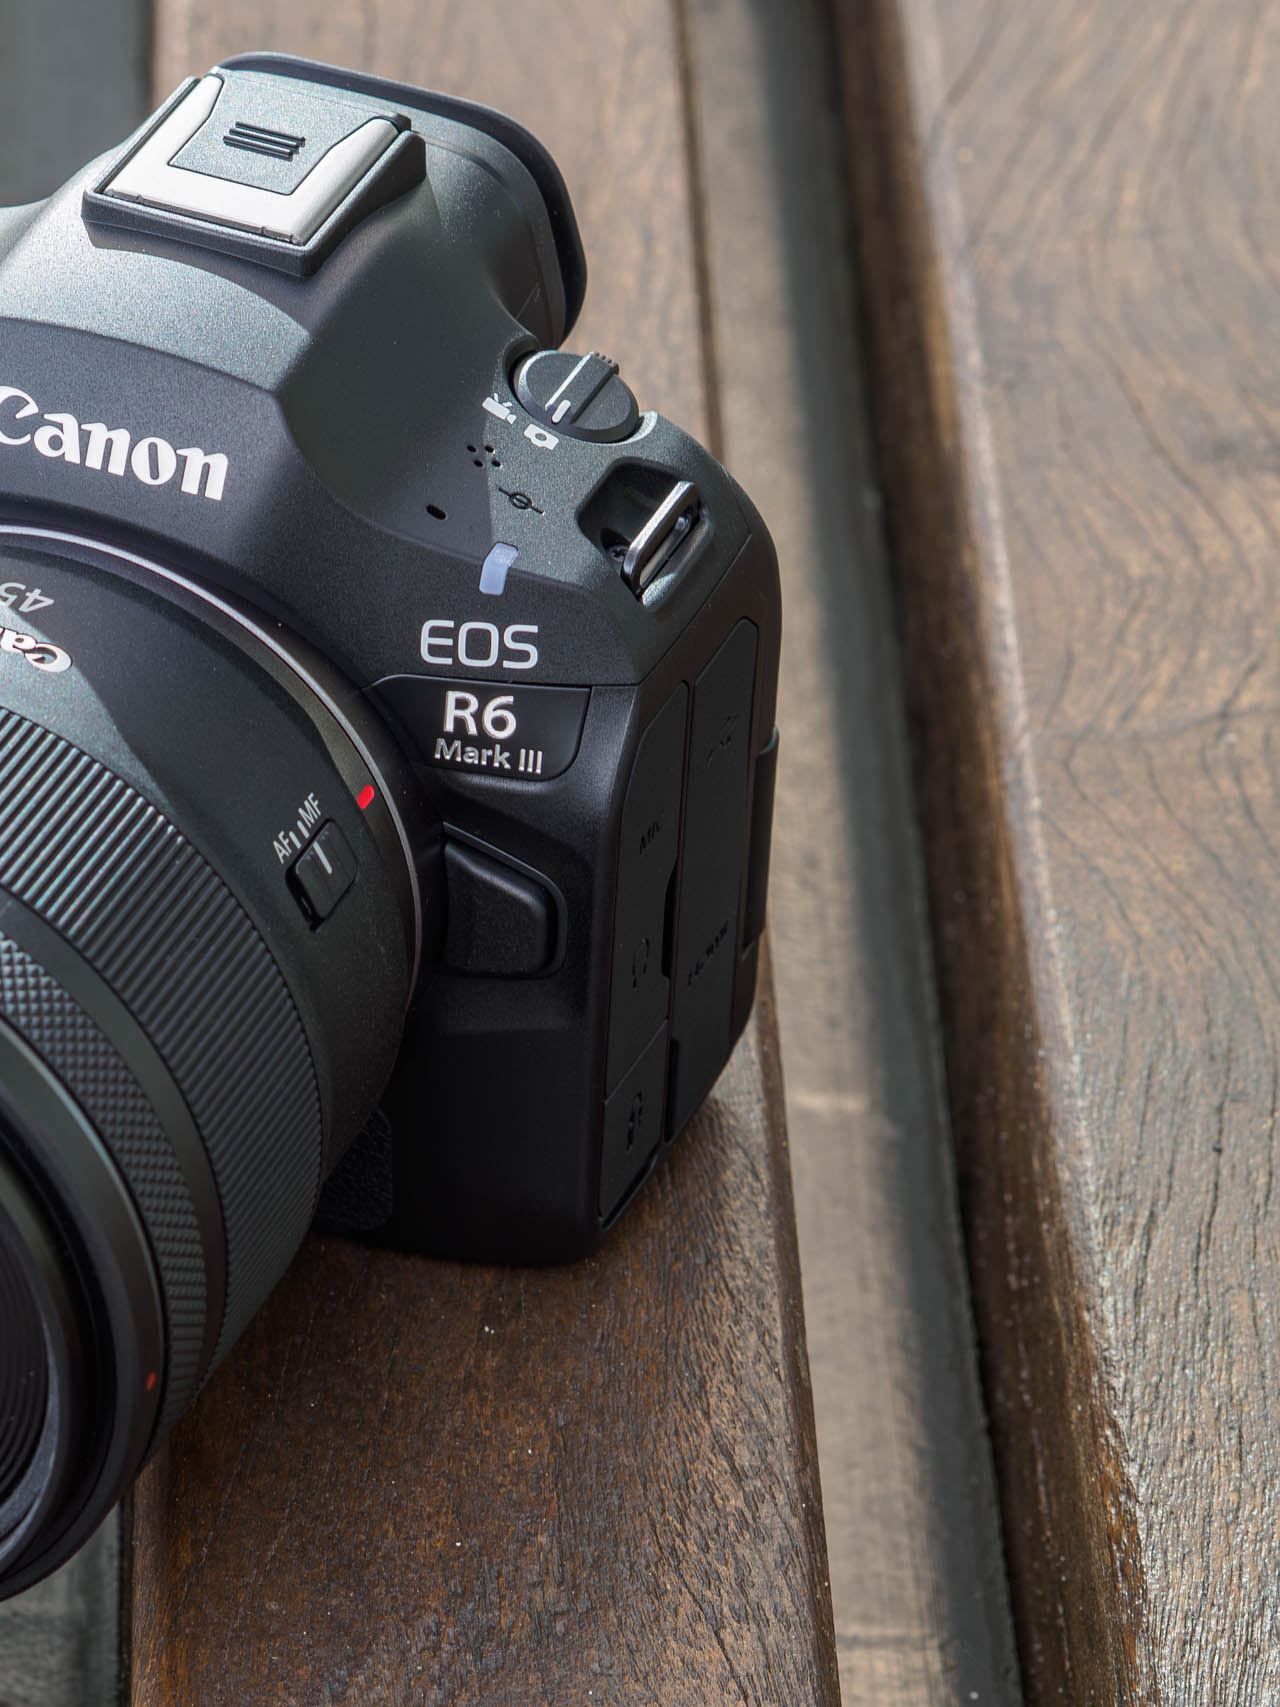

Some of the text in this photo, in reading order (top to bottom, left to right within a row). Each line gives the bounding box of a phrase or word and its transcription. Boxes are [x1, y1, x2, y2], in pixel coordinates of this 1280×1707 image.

[420, 619, 539, 670] EOS
[443, 690, 517, 740] R6
[434, 737, 543, 775] Mark III
[297, 792, 322, 828] MF
[272, 830, 293, 864] AF
